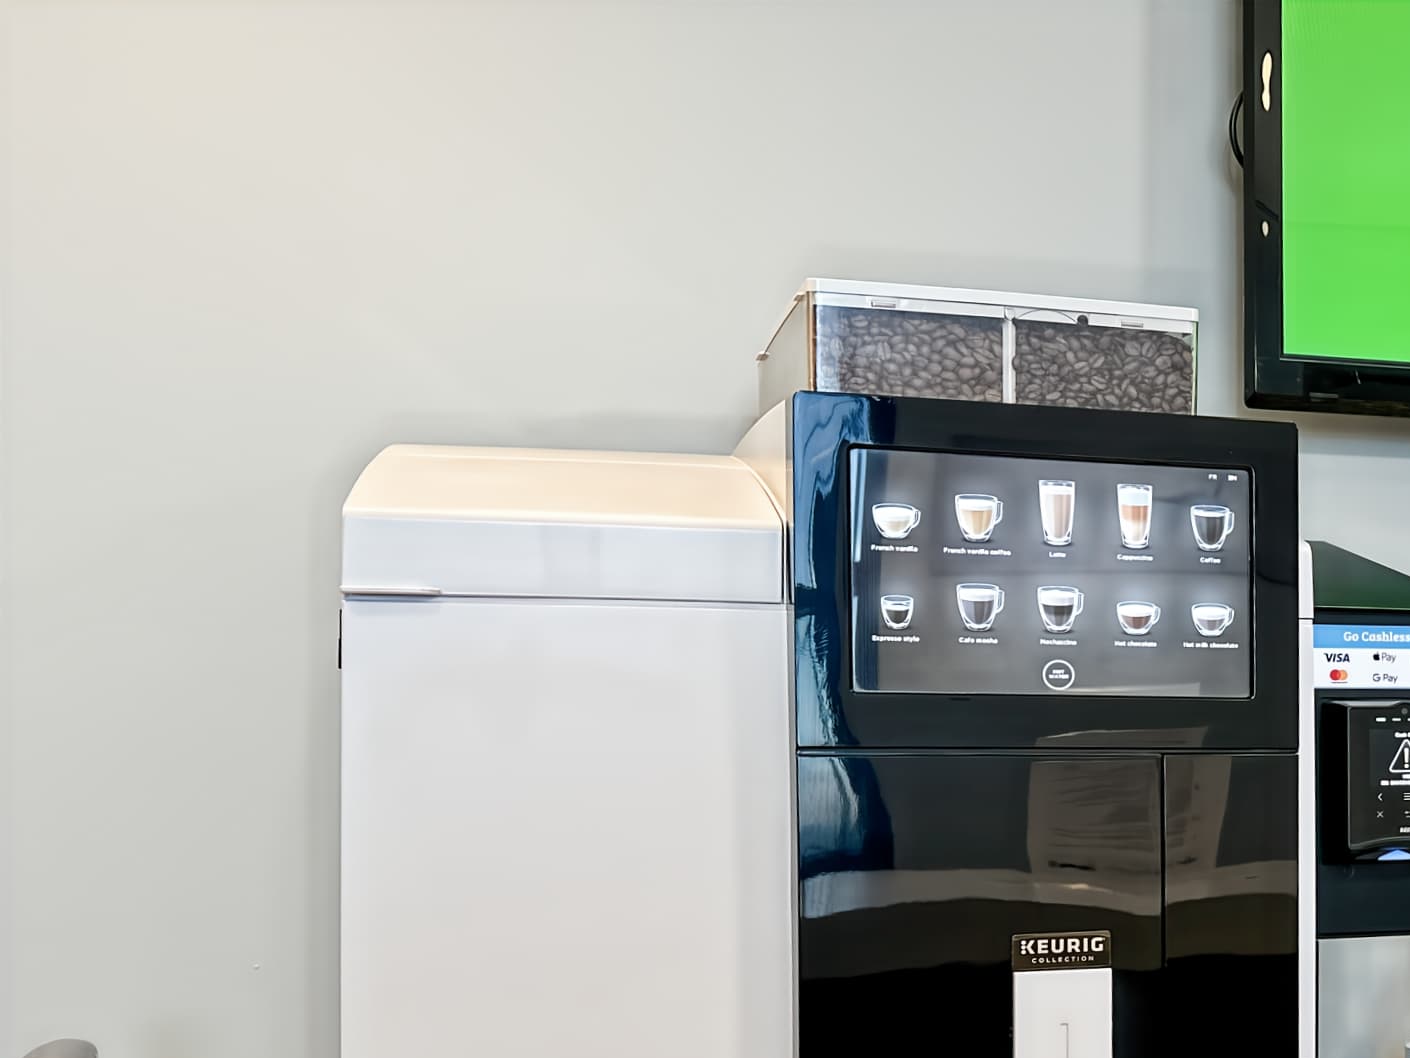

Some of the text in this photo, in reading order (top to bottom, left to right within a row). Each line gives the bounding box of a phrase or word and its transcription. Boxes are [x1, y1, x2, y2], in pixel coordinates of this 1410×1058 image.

[1343, 632, 1410, 643] Go Cashless
[1324, 653, 1350, 663] VISA
[1381, 653, 1396, 664] Pay
[1383, 673, 1398, 684] Pay
[1020, 937, 1105, 955] KEURIG
[1031, 955, 1094, 964] COLLECTION
